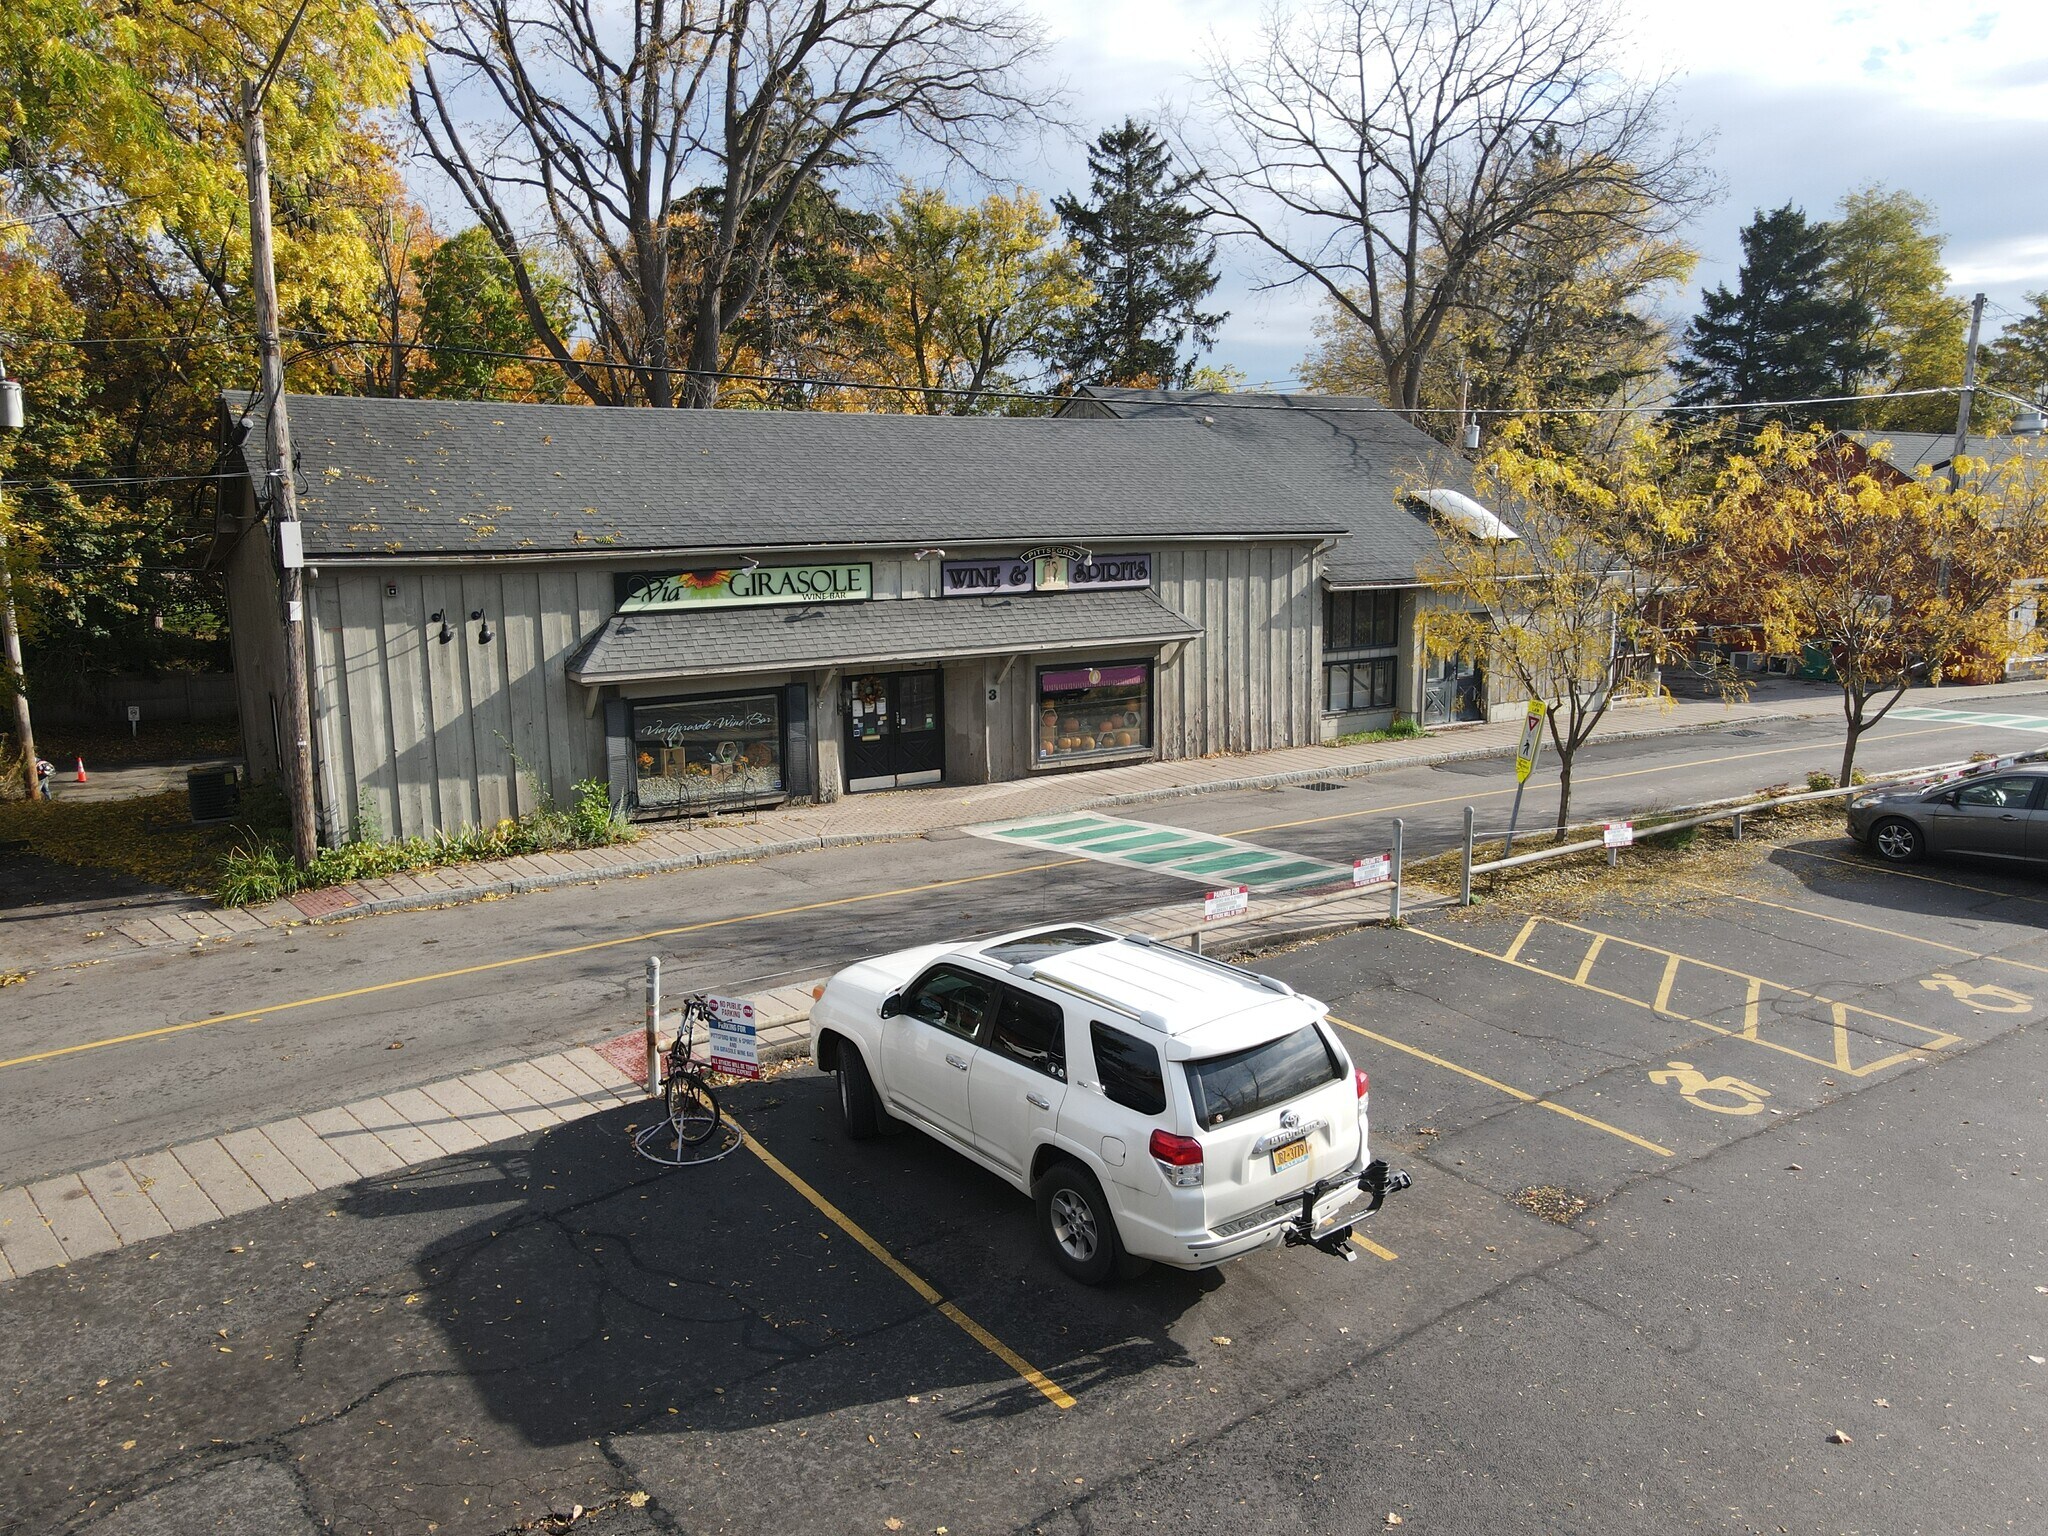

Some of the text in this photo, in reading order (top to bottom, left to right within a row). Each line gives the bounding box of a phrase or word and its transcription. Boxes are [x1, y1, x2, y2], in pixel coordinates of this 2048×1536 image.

[1028, 547, 1075, 558] PITTSFORD
[947, 561, 1148, 588] WINE & SPIRITS
[627, 569, 862, 602] Via GIRASOLE
[989, 689, 997, 700] 3
[667, 720, 712, 741] Girasole
[713, 715, 744, 728] Wine
[746, 712, 771, 726] Bar
[727, 1002, 741, 1010] PUBLIC
[722, 1009, 740, 1018] PARKING
